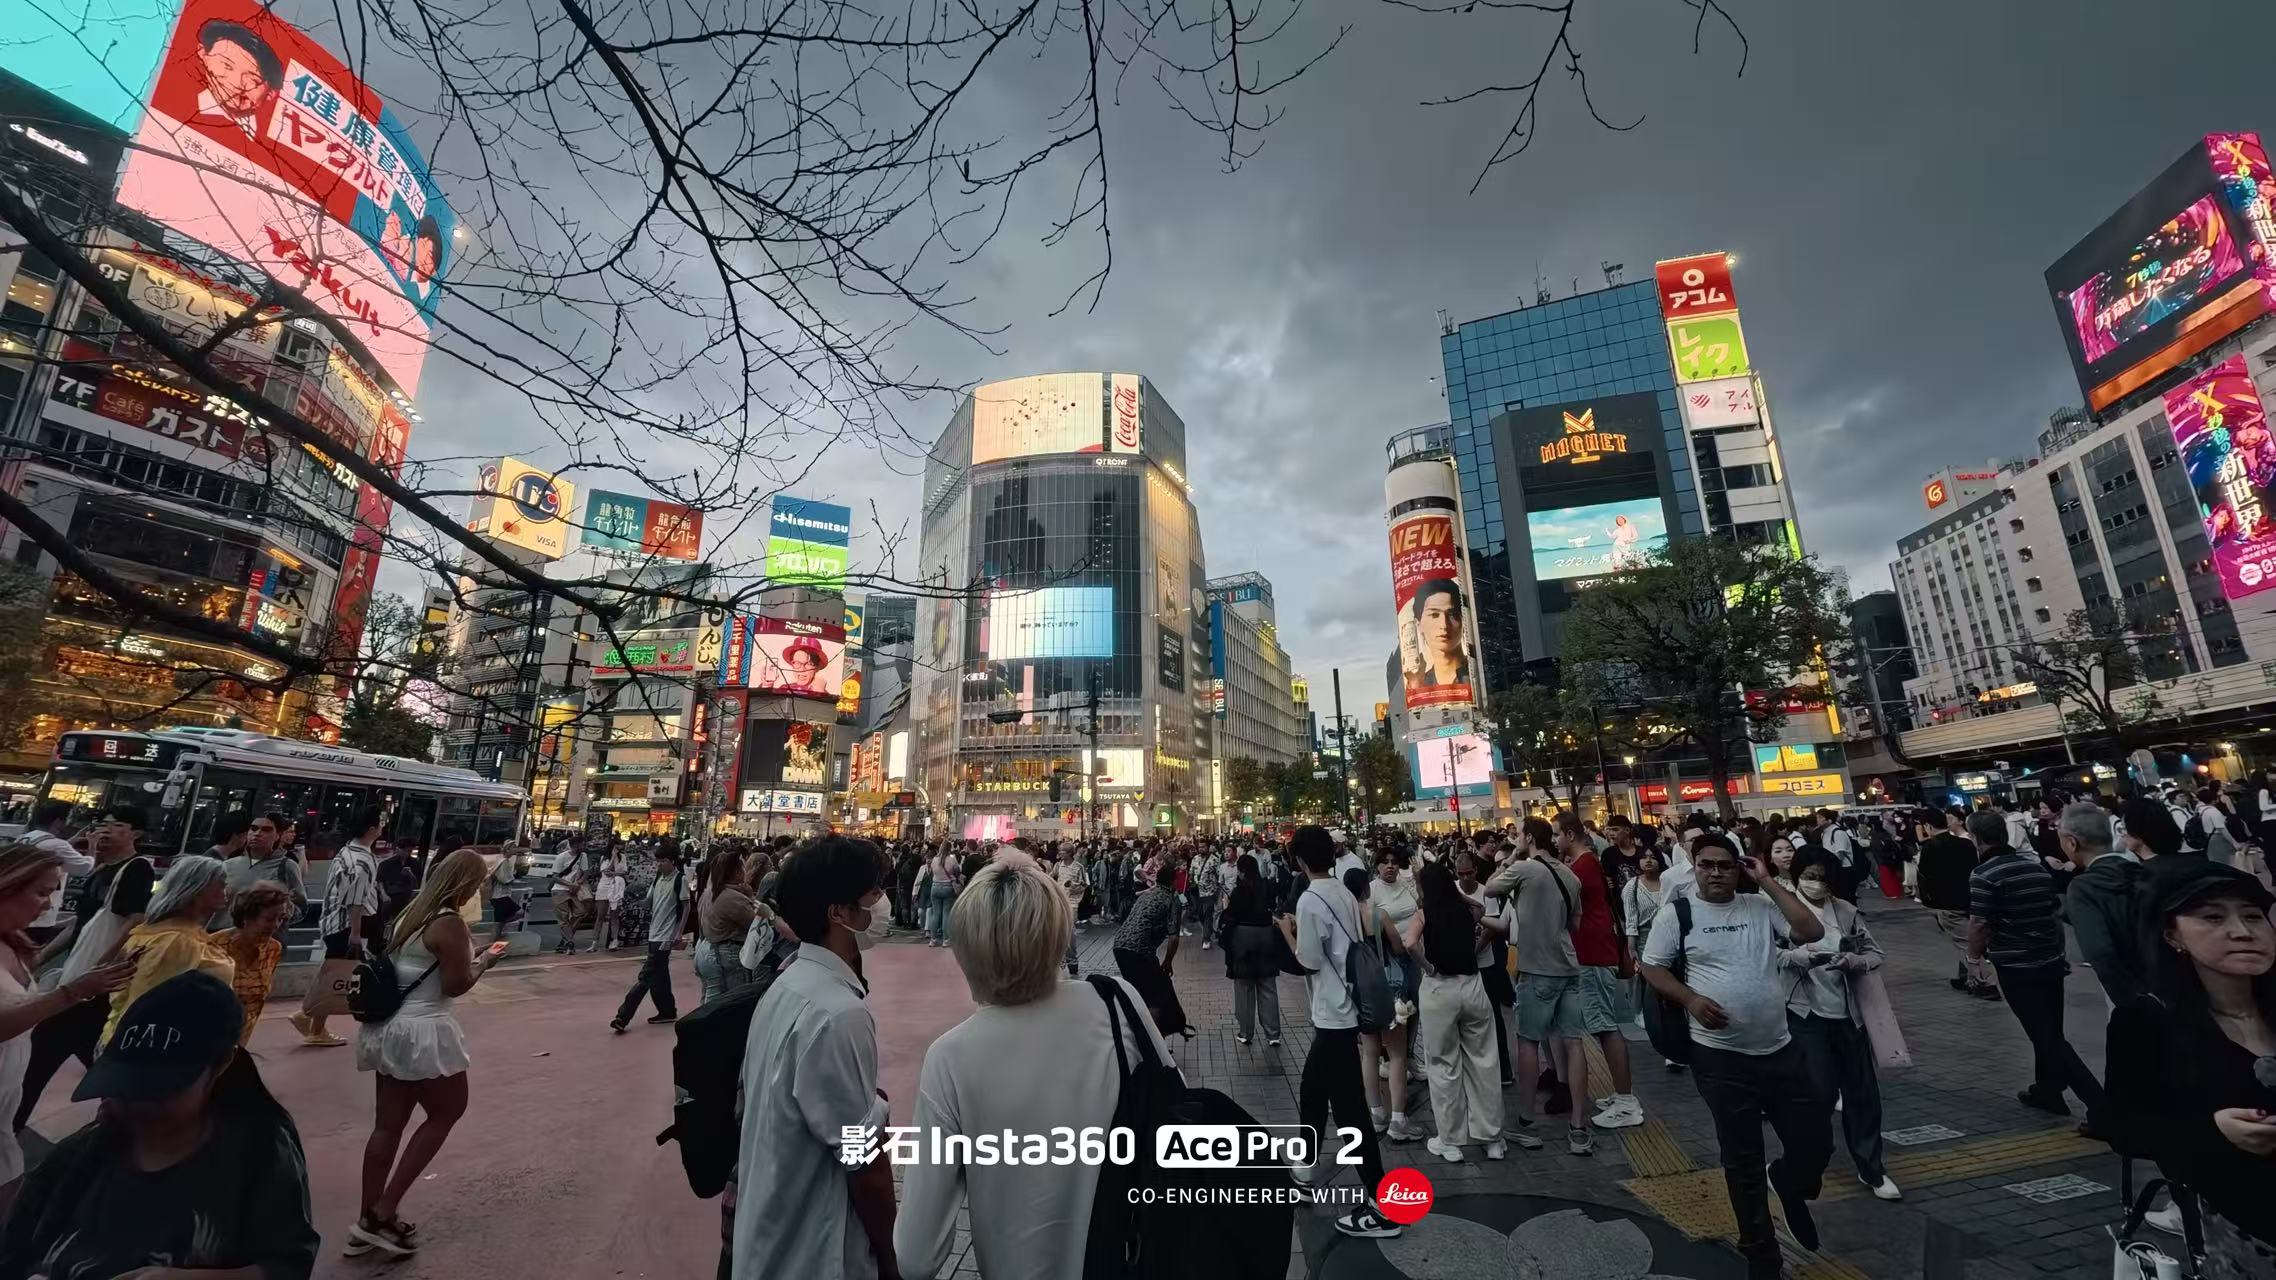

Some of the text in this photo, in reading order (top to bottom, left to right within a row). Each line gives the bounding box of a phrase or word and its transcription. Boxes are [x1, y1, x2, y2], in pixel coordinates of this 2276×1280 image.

[281, 108, 391, 203] ヤクルト
[99, 263, 130, 283] 9F
[263, 224, 381, 338] Yakult
[1669, 288, 1727, 309] アコム
[1678, 328, 1729, 367] レイク
[59, 376, 97, 400] 7F
[104, 391, 145, 412] Café
[145, 406, 233, 449] ガスト
[1114, 384, 1137, 448] Coca-Cola
[1541, 432, 1628, 464] MAGNET
[333, 463, 360, 490] ガスト
[774, 512, 849, 534] Hisamitsu
[536, 535, 557, 548] VISA
[1391, 523, 1450, 556] NEW
[785, 621, 822, 634] Rakuten
[1213, 678, 1225, 712] SEIBU
[104, 740, 159, 758] 回送
[977, 781, 1050, 792] STARBUCK
[1779, 779, 1825, 792] プロミス
[1702, 923, 1748, 933] carhartt
[120, 1023, 181, 1051] GAP
